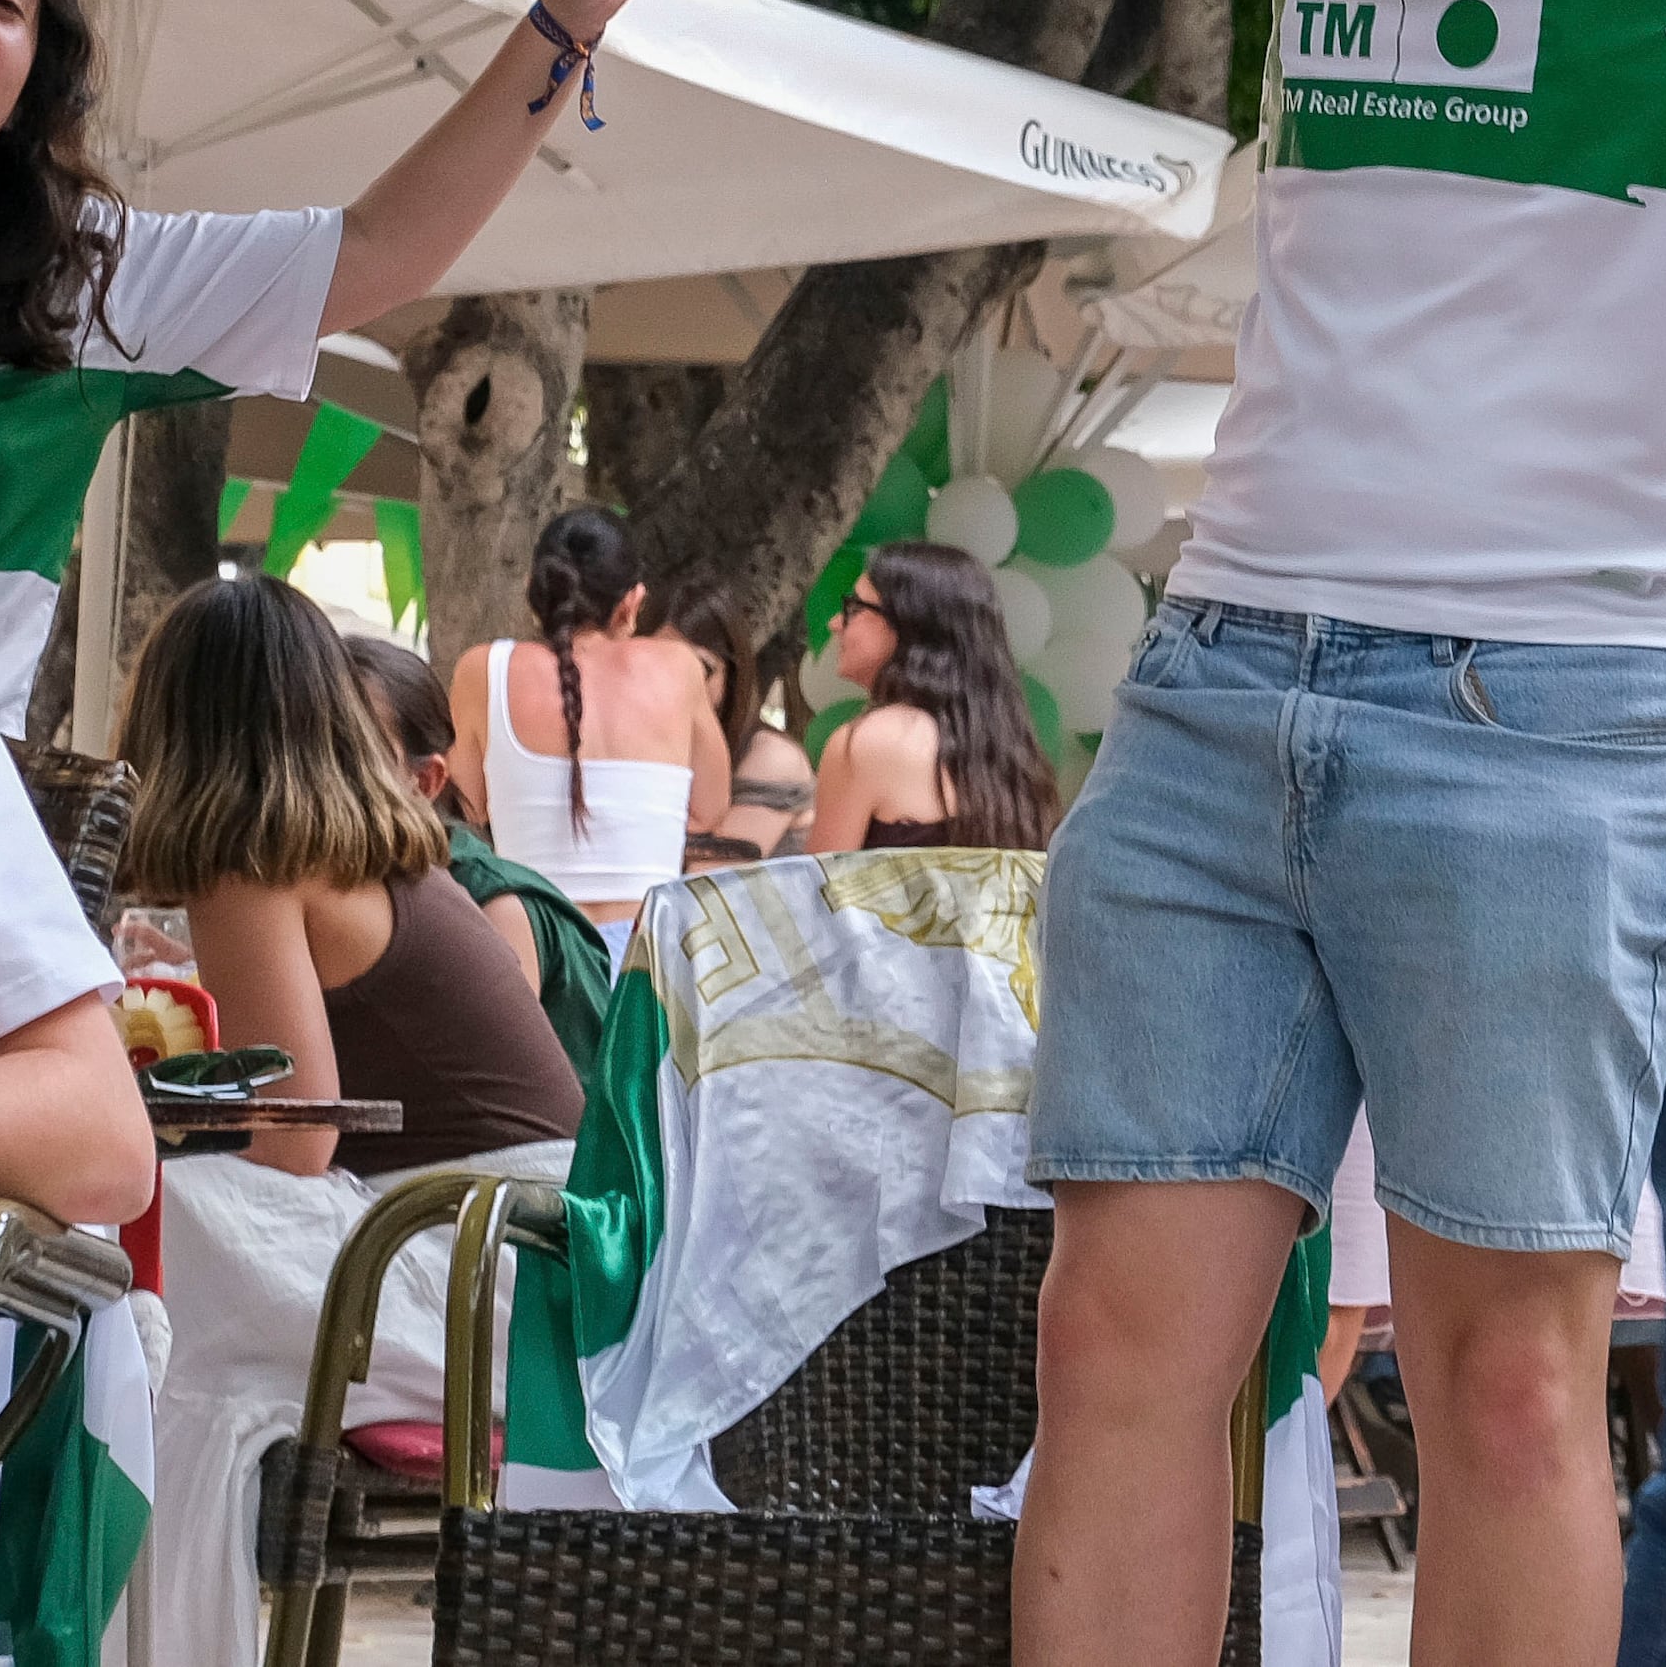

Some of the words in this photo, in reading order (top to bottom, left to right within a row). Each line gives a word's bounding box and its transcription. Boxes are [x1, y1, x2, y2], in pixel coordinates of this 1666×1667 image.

[1296, 1, 1377, 58] TM
[1283, 88, 1304, 112] M
[1309, 89, 1358, 117] Real
[1363, 91, 1437, 121] Estate
[1444, 95, 1529, 134] Group
[1019, 118, 1166, 193] GUINNESS
